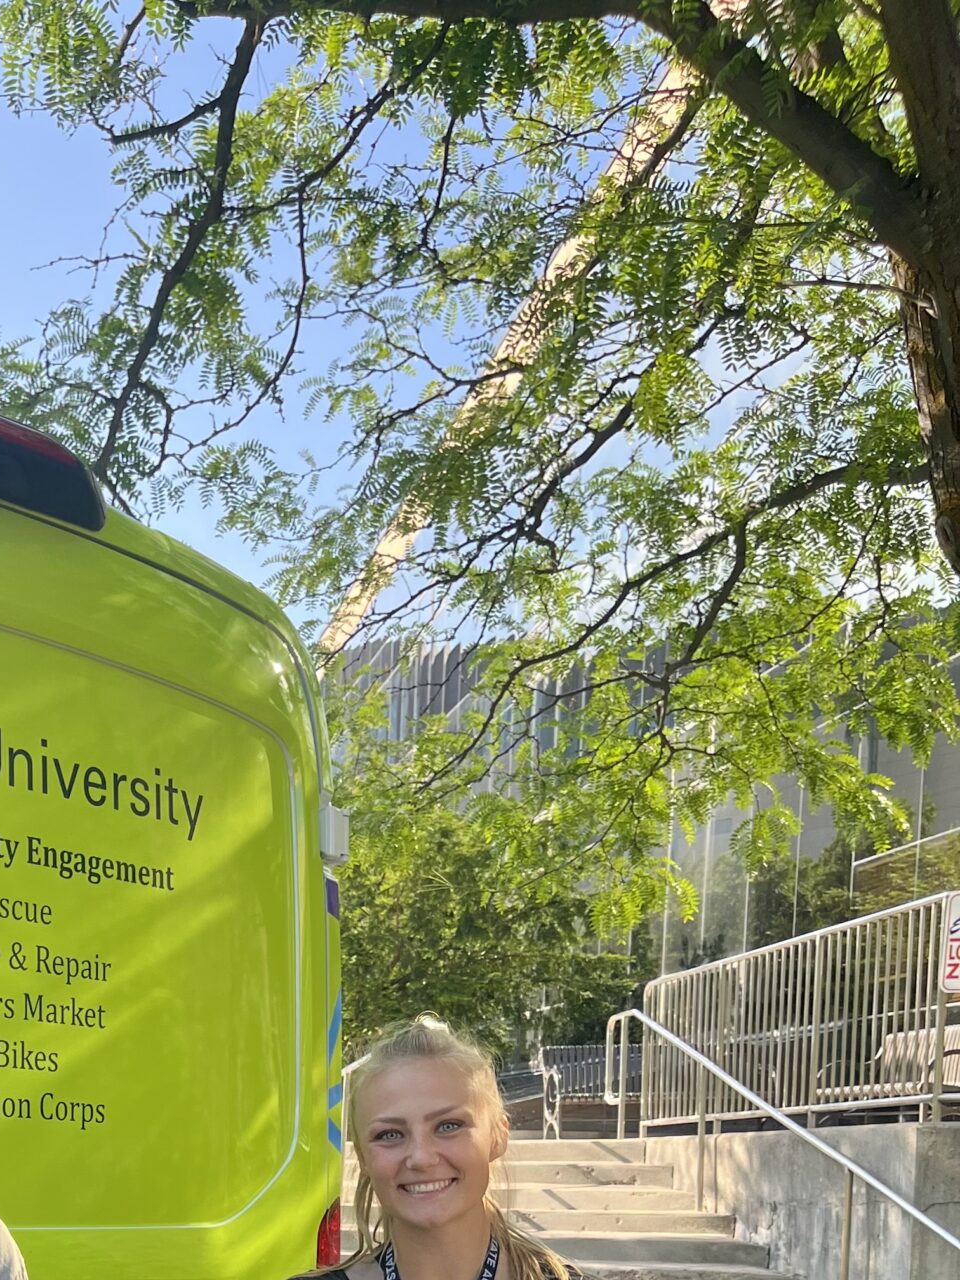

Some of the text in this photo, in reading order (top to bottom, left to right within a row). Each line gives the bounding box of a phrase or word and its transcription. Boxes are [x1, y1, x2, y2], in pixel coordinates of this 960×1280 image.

[27, 836, 175, 891] Engagement
[9, 941, 28, 971] &
[36, 944, 112, 984] Repair
[24, 993, 106, 1029] Market
[40, 1092, 106, 1130] Corps
